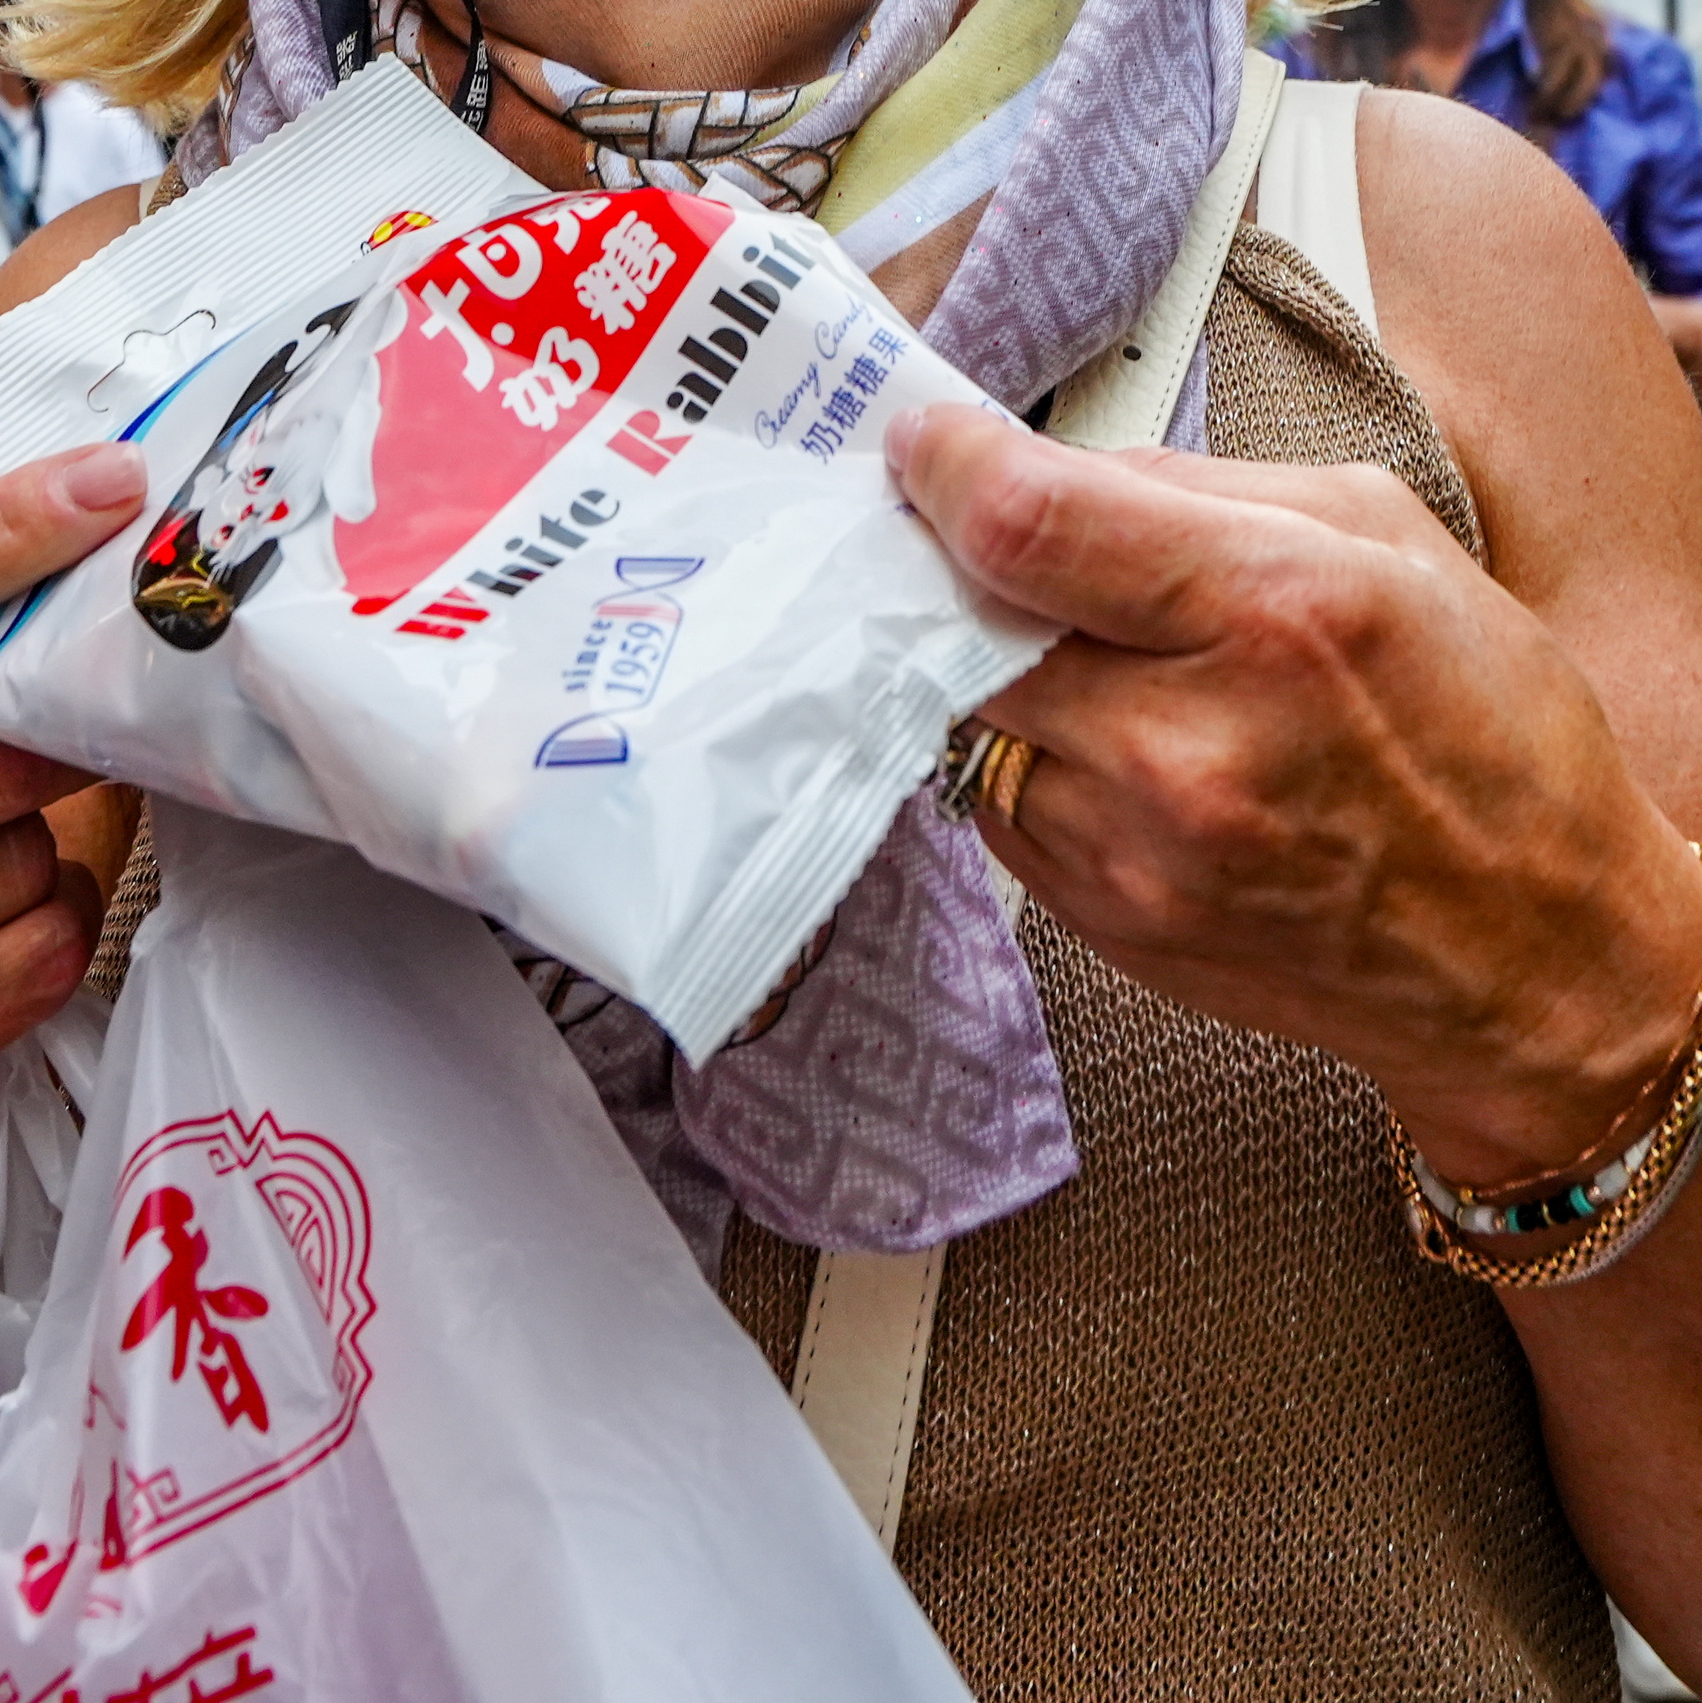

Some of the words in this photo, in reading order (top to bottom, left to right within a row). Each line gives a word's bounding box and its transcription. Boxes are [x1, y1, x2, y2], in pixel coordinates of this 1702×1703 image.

[499, 210, 677, 431] 奶糖
[754, 361, 822, 449] Creamy
[815, 298, 874, 360] Candy
[394, 488, 620, 640] White
[605, 231, 817, 477] Rabbit
[800, 327, 909, 465] 奶糖糖果
[562, 617, 613, 694] since
[605, 619, 665, 696] 1959
